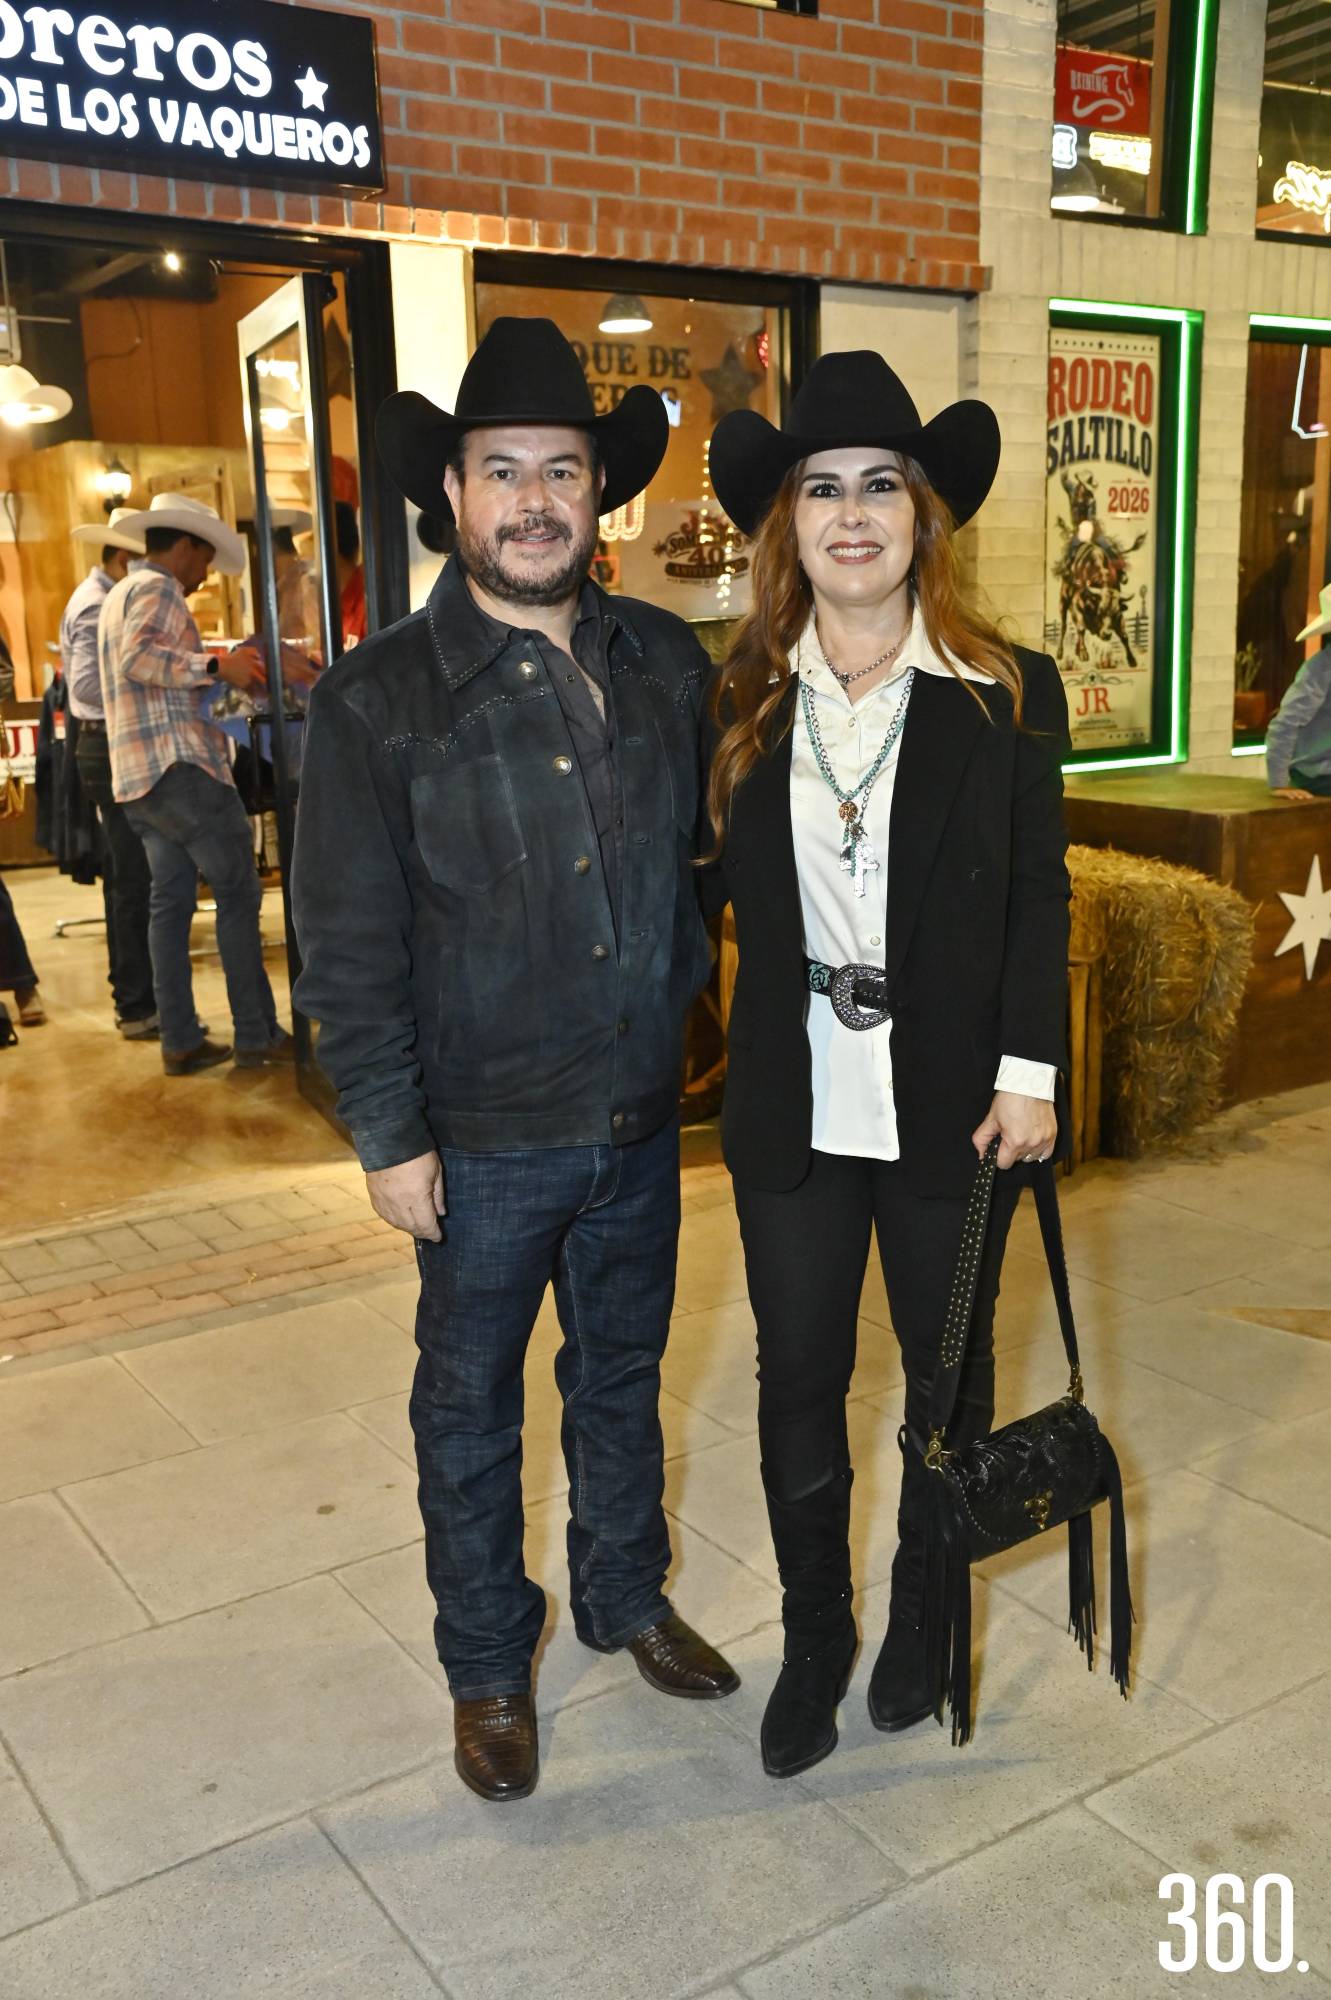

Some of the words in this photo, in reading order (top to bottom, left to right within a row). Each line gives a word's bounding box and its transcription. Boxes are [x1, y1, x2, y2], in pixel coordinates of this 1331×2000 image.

[57, 84, 139, 138] LOS
[149, 97, 370, 168] VAQUEROS
[648, 345, 691, 379] DE
[1048, 357, 1153, 426] RODEO
[1047, 416, 1152, 477] SALTILLO
[1108, 487, 1150, 513] 2026
[1076, 687, 1112, 716] JR
